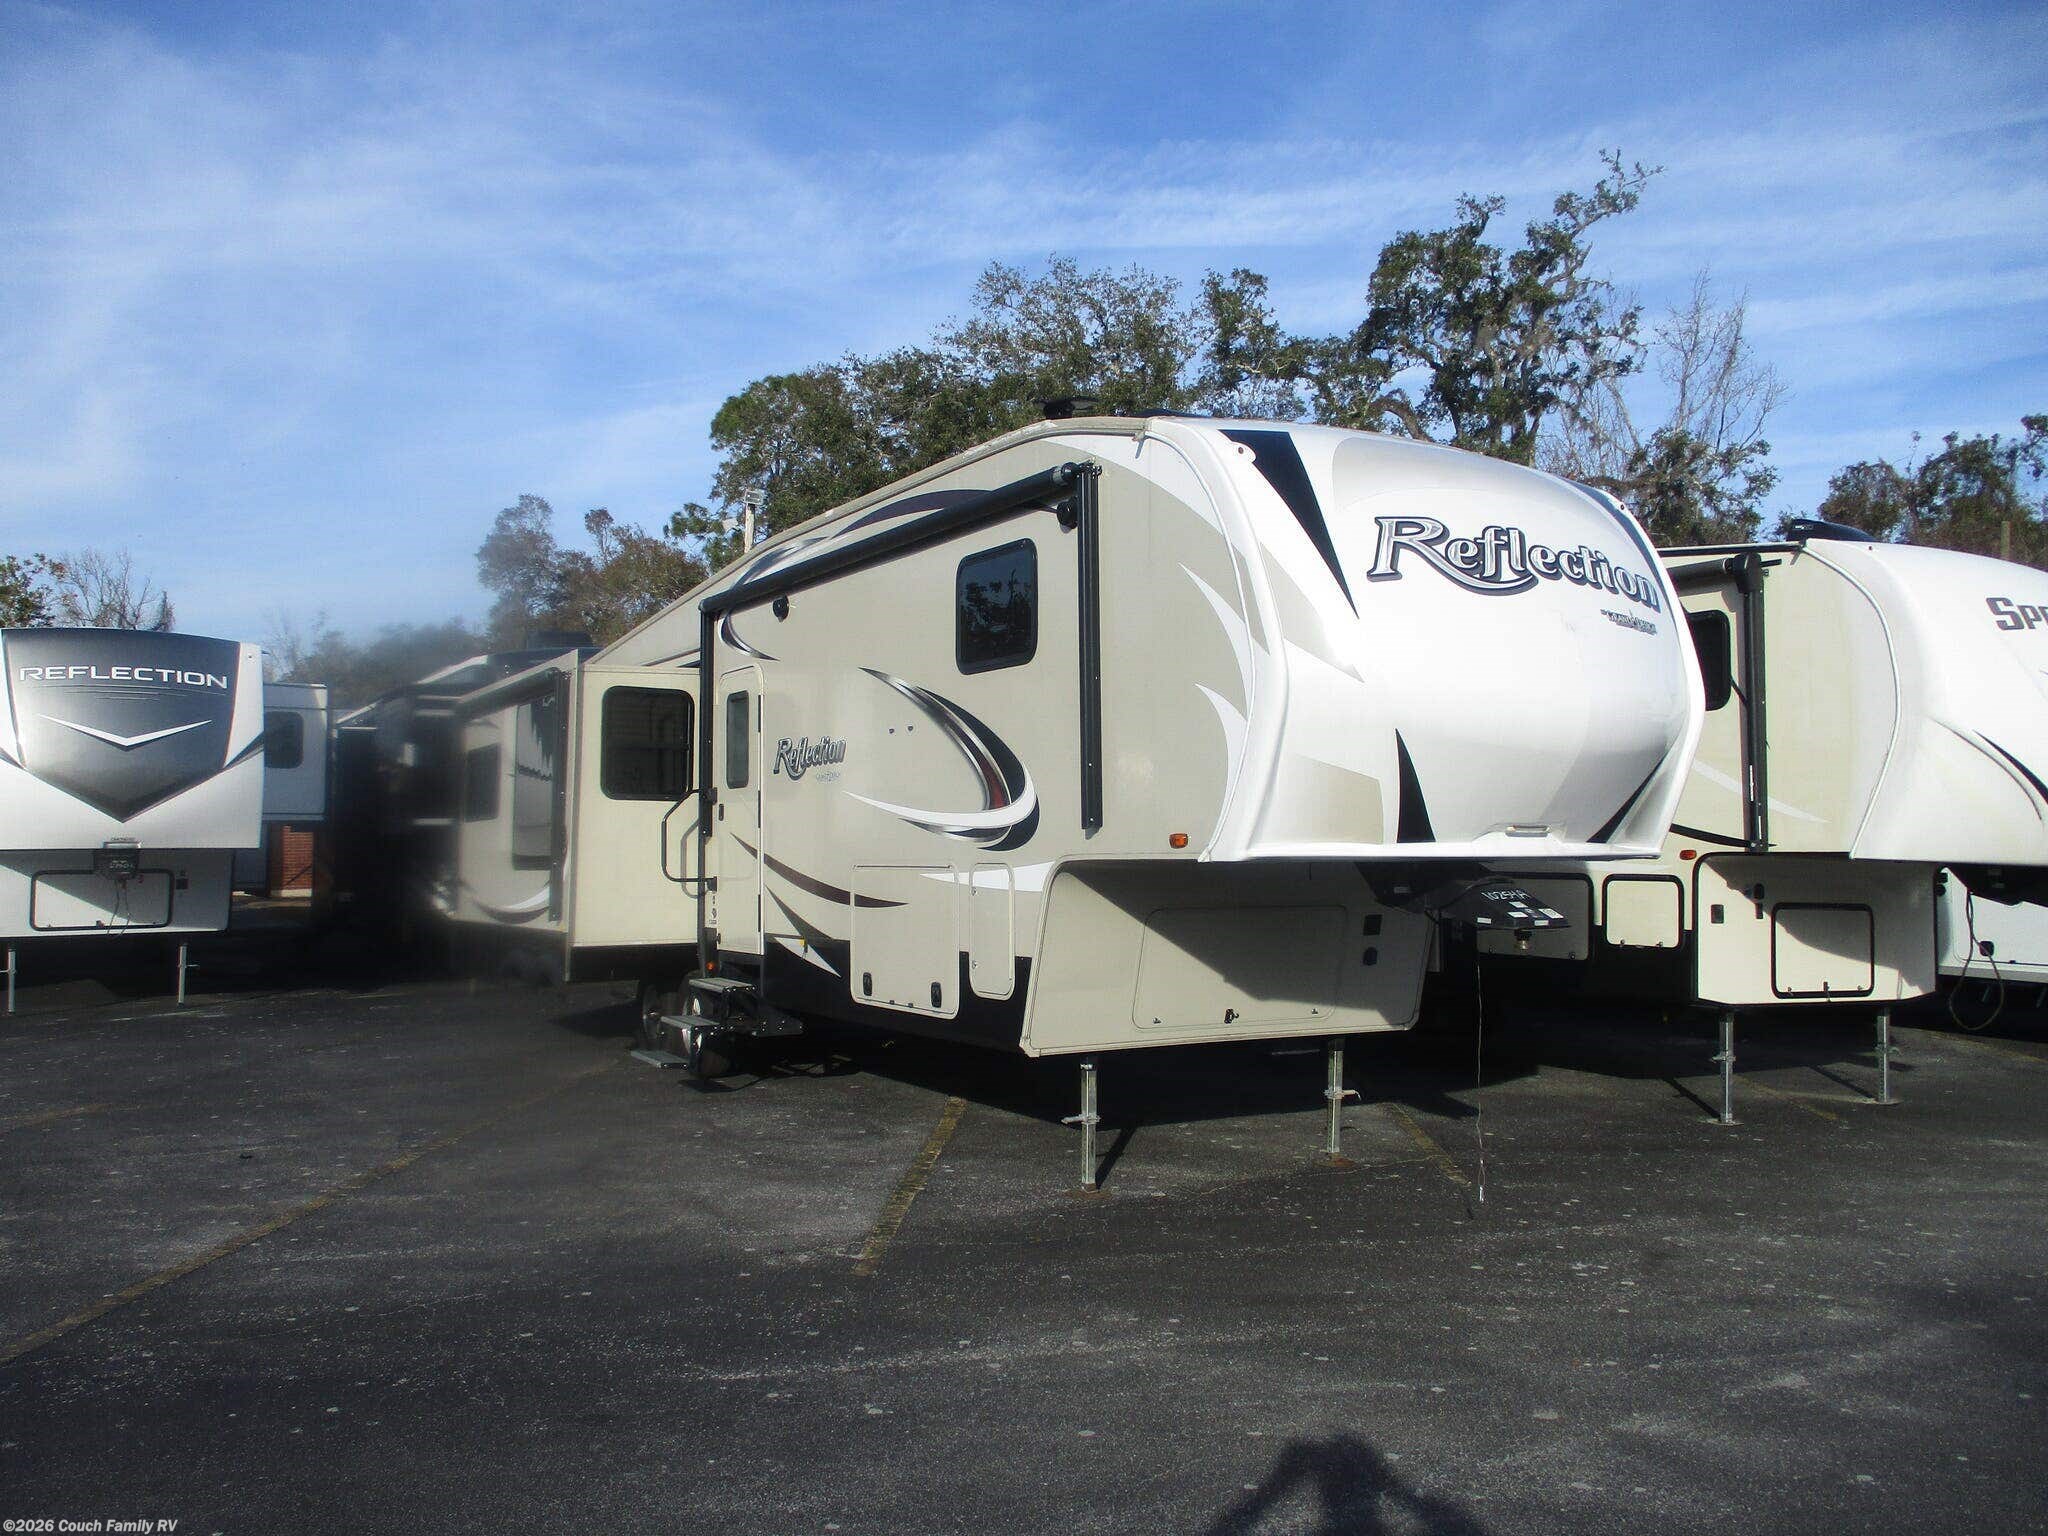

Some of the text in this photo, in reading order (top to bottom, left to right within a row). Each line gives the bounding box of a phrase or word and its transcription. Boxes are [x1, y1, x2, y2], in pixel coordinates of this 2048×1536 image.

[1366, 516, 1661, 614] Reflection
[19, 665, 228, 689] REFLECTION
[773, 737, 846, 781] Reflection
